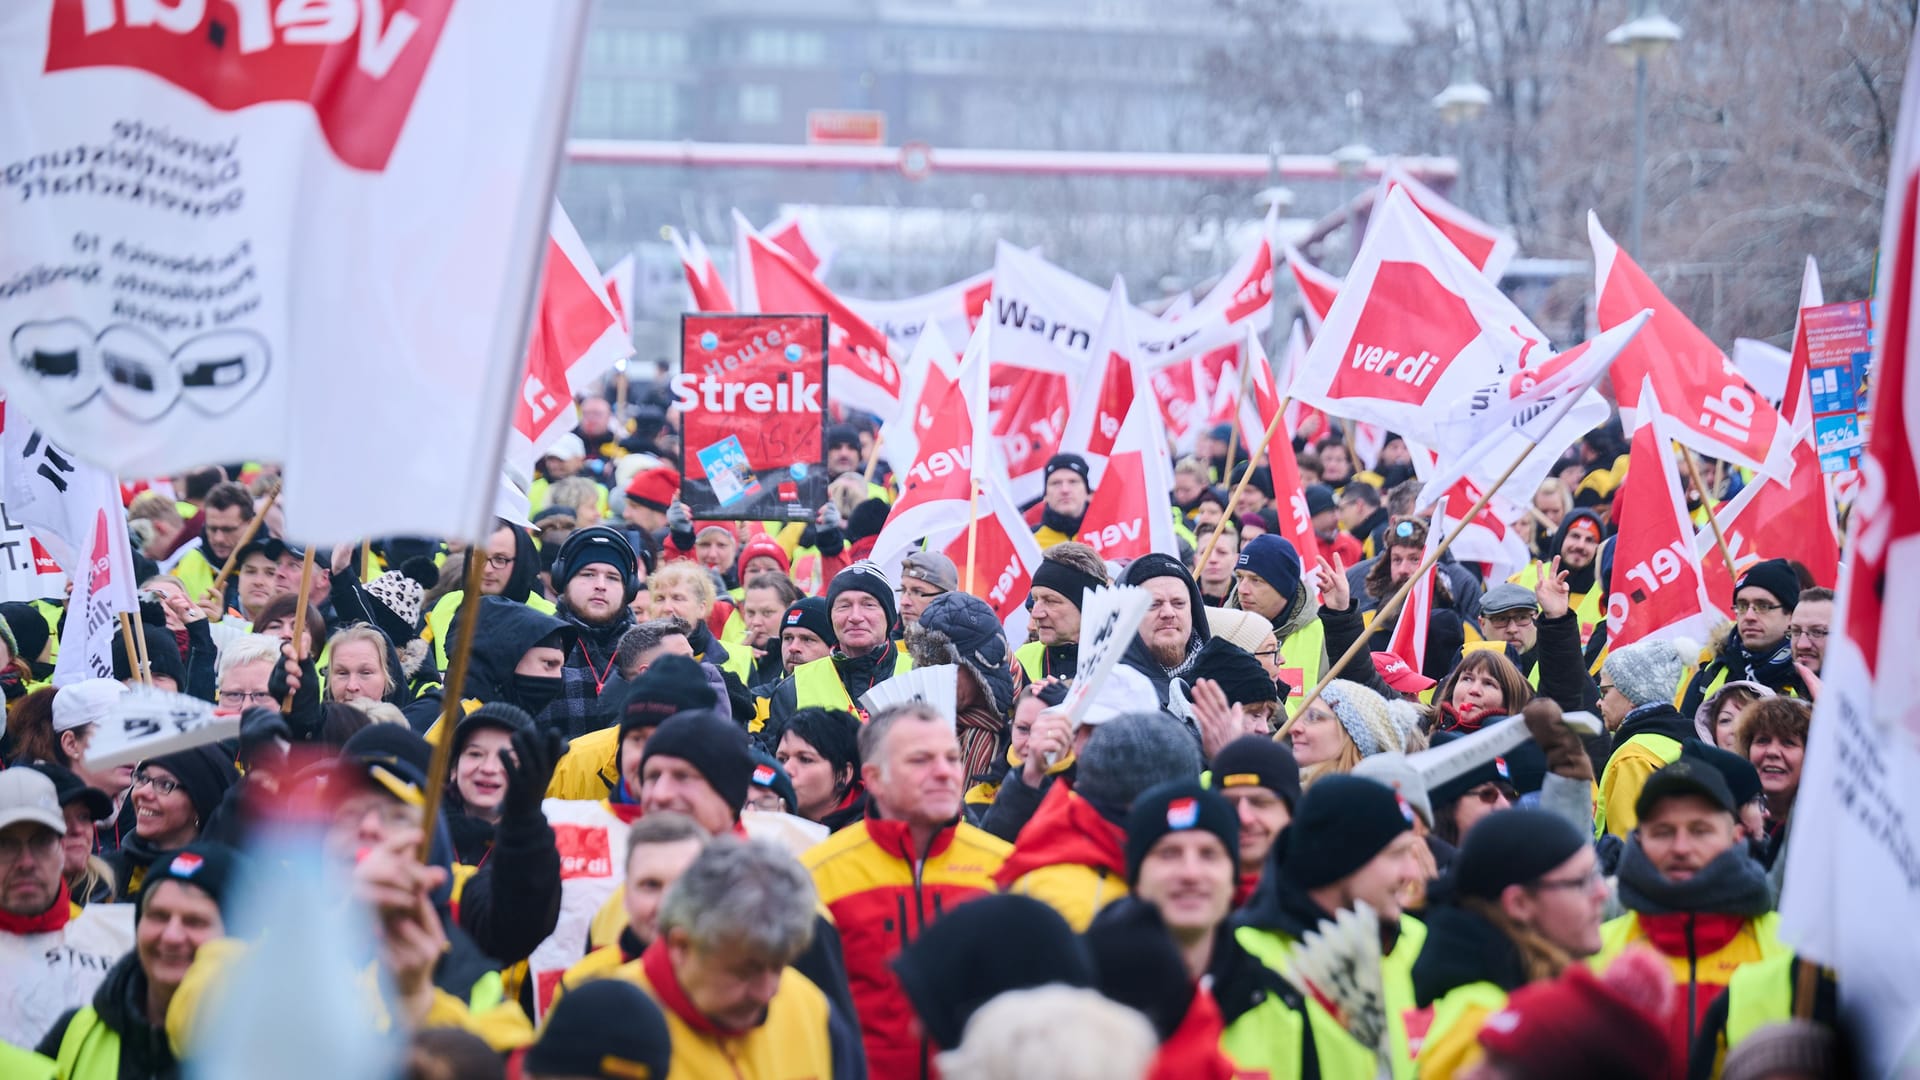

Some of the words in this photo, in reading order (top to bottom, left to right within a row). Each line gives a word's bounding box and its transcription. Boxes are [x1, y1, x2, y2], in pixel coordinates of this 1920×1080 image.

[997, 295, 1090, 351] Warn
[703, 324, 791, 377] Heute:
[1351, 343, 1441, 387] ver.di
[670, 371, 821, 413] Streik
